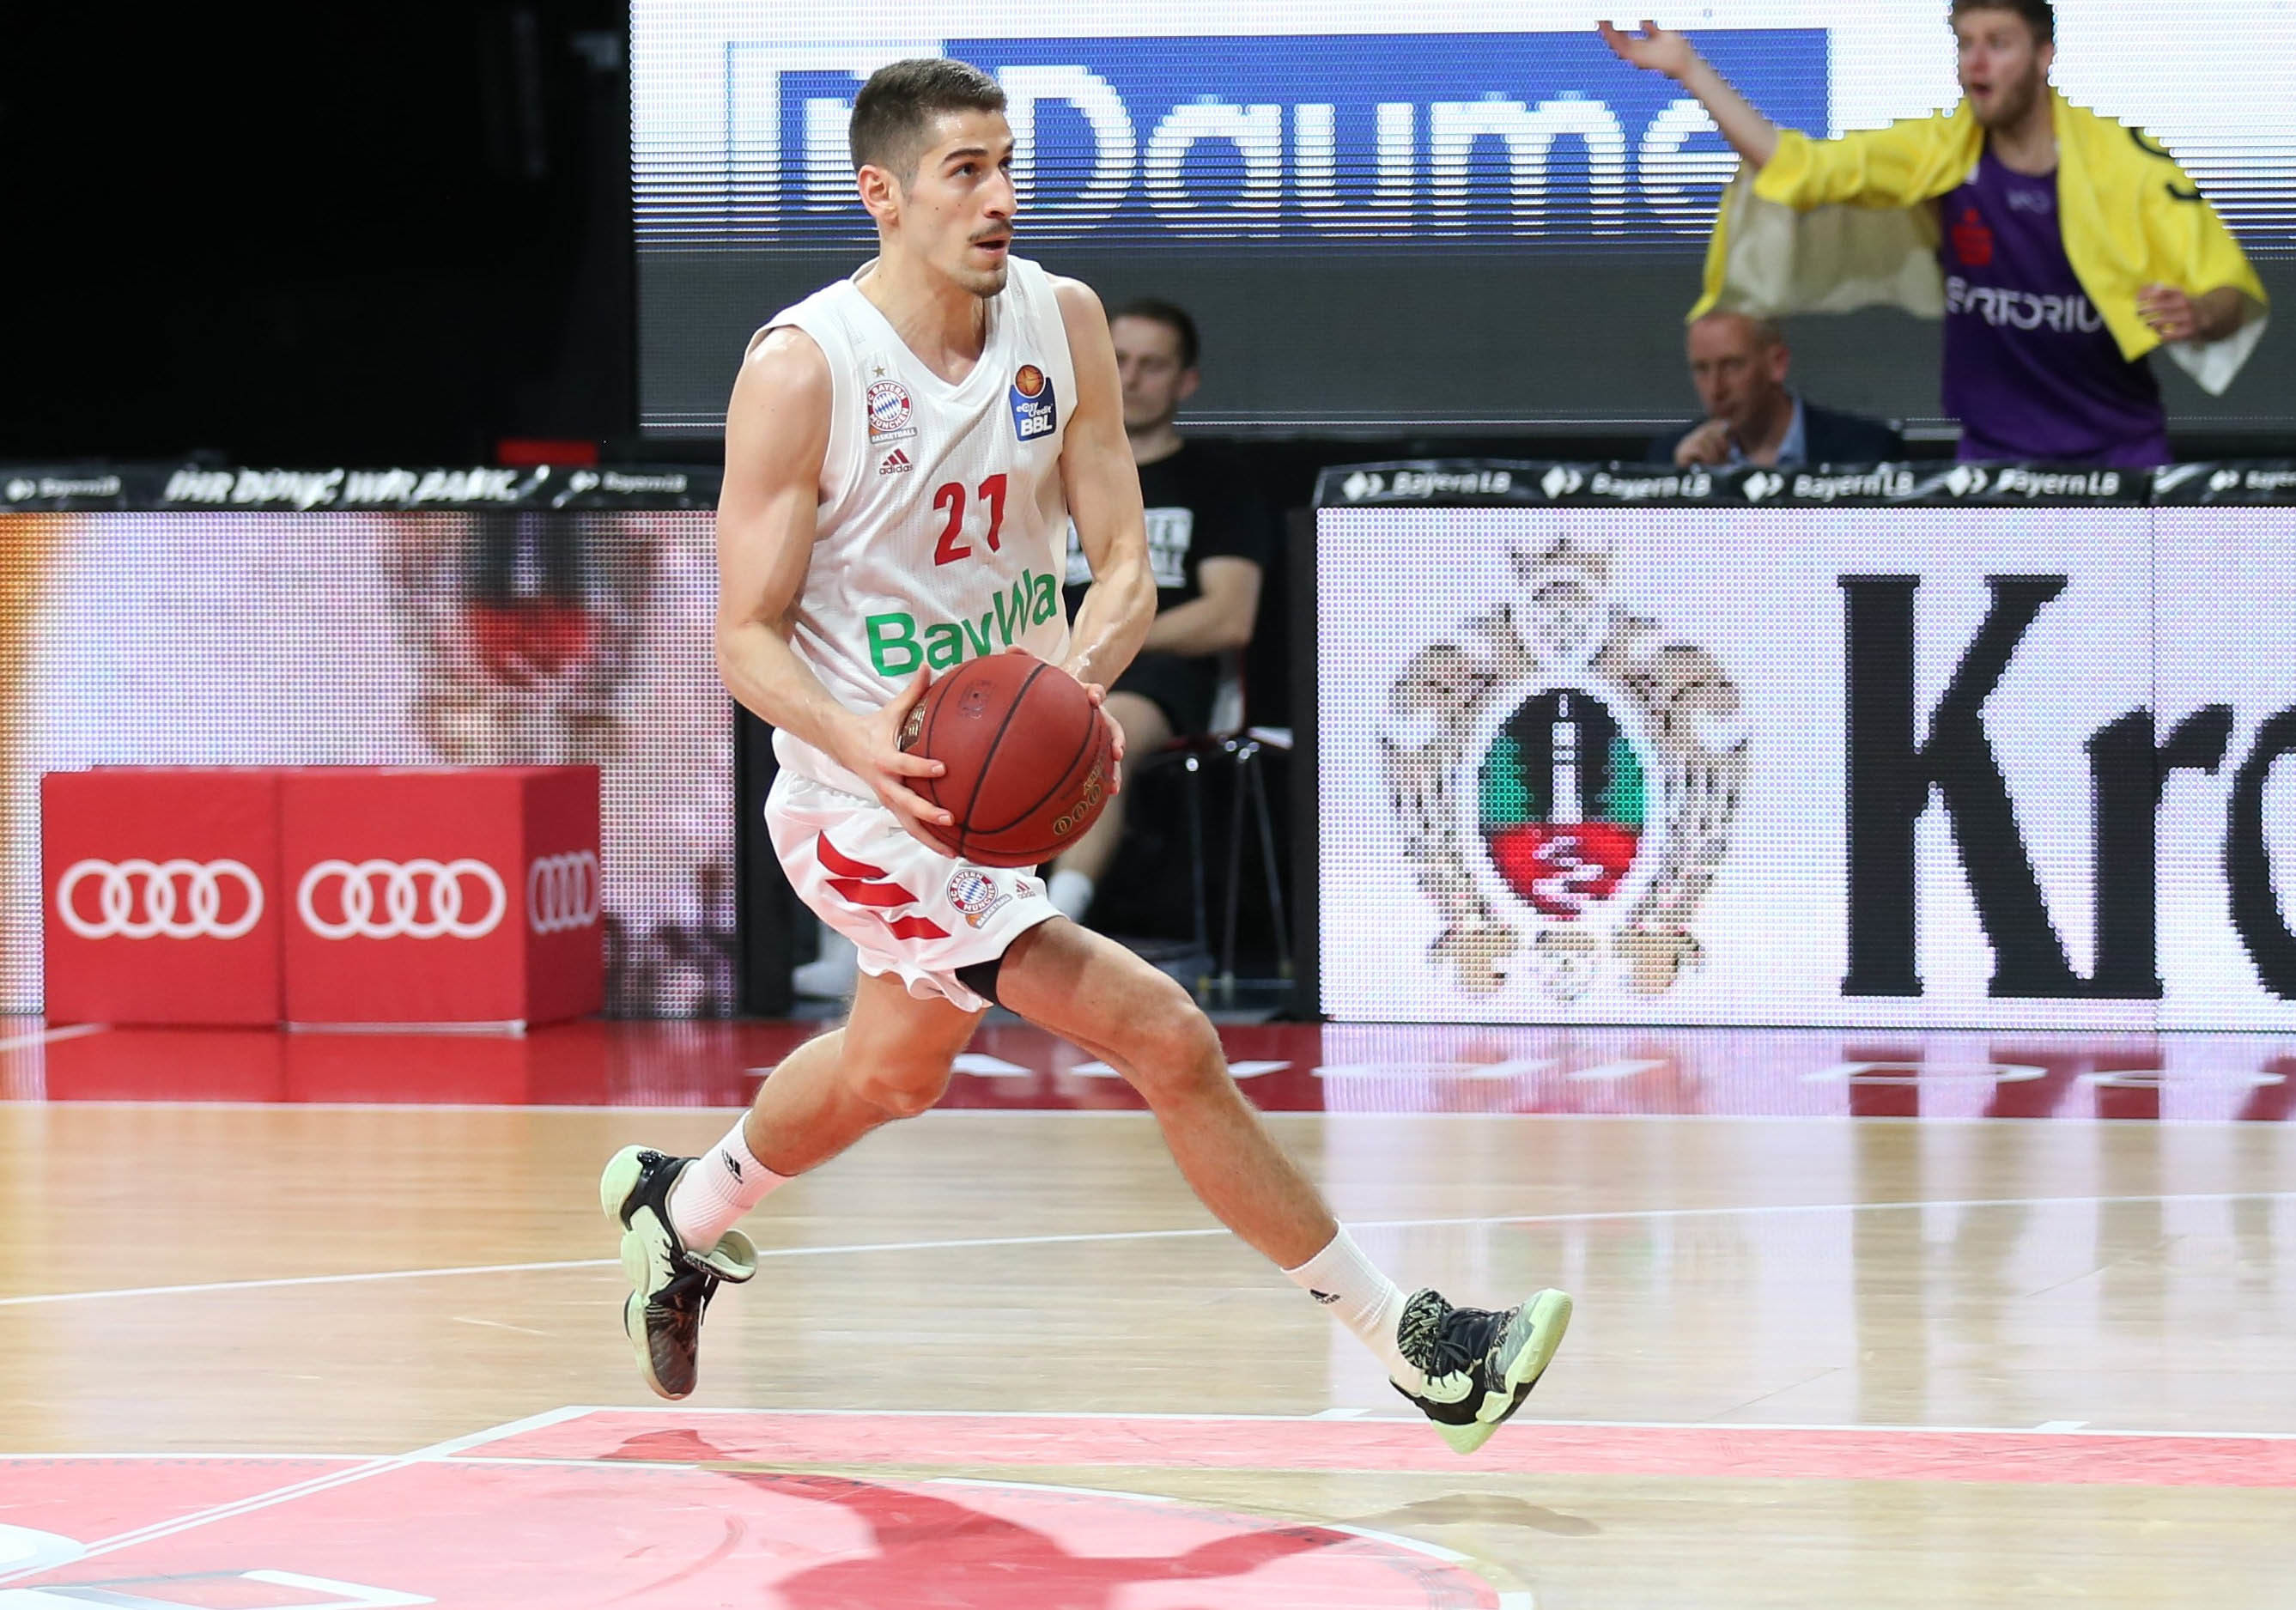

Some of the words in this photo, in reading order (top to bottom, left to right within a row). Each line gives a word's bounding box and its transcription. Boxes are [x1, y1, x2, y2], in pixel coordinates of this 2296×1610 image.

[872, 383, 908, 400] BAYERN
[1020, 414, 1053, 436] BBL
[879, 465, 914, 475] adidas
[1392, 471, 1512, 499] BayernLB
[1590, 471, 1711, 499] BayernLB
[1793, 470, 1916, 501] BayernLB
[1996, 467, 2120, 498] BayernLB
[932, 472, 1008, 567] 21
[865, 568, 1058, 677] BayWa
